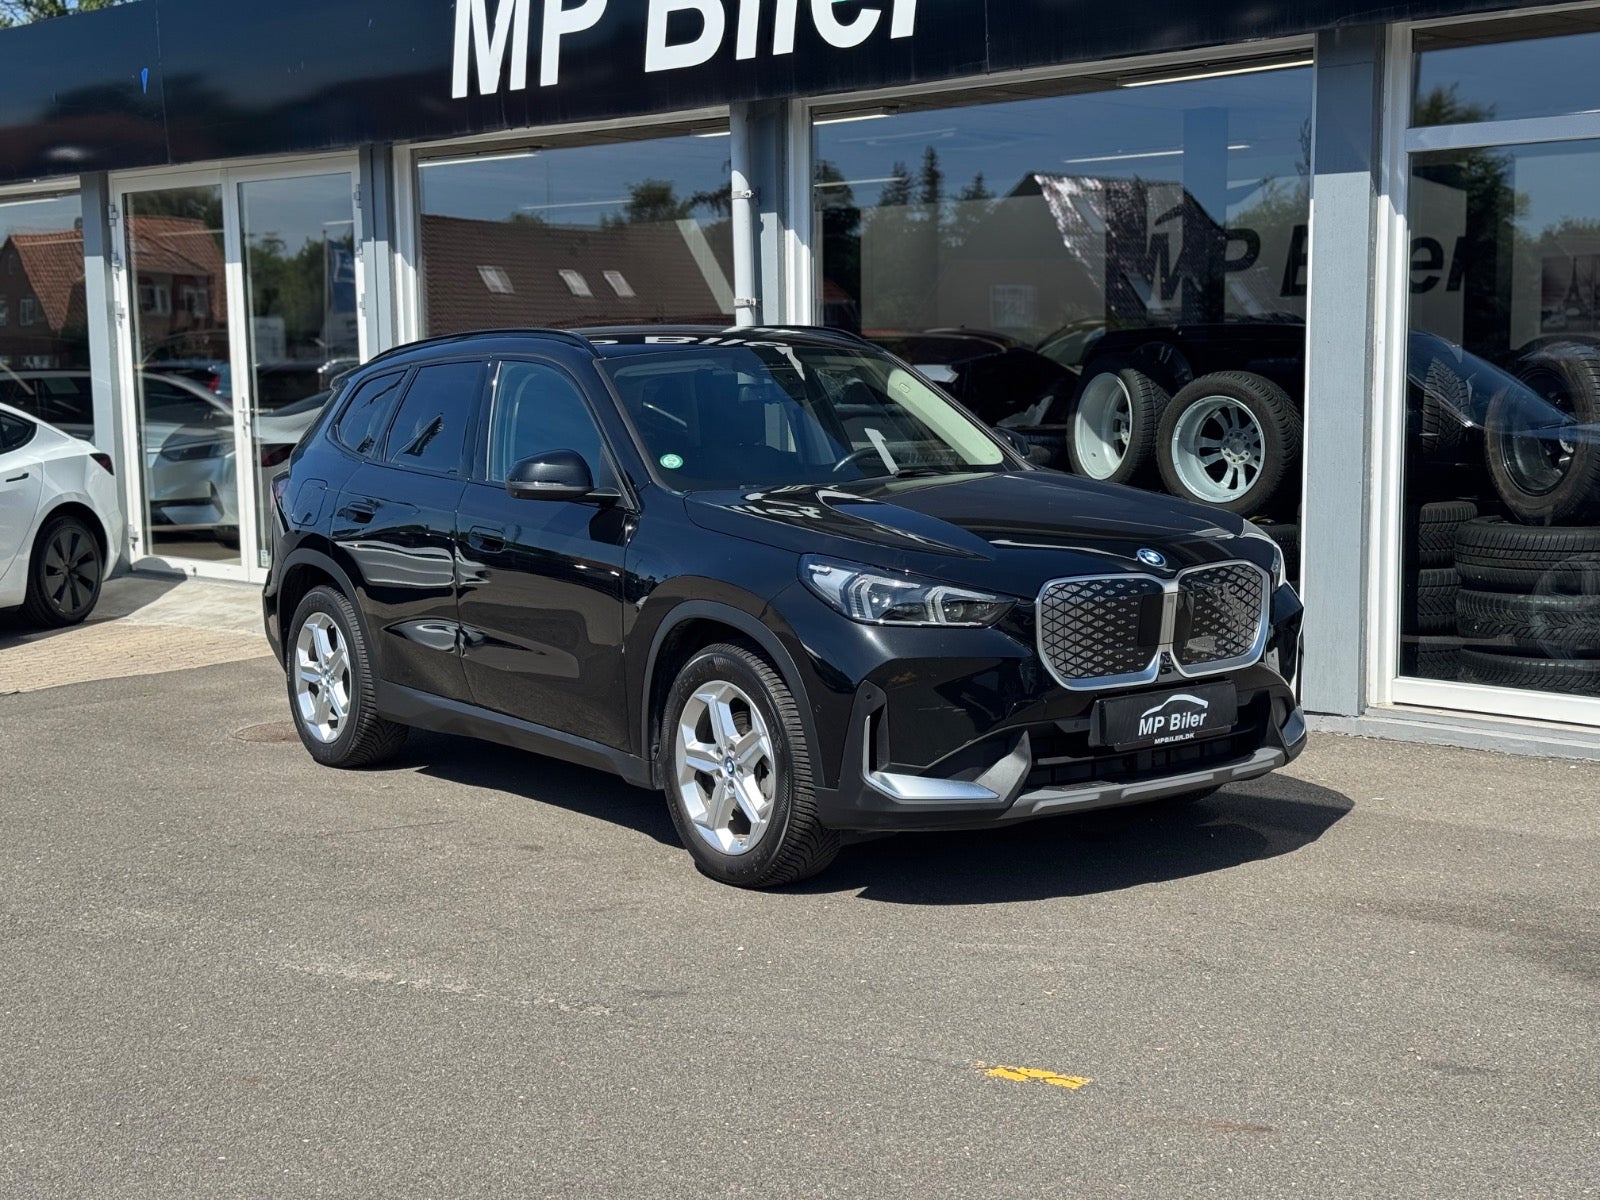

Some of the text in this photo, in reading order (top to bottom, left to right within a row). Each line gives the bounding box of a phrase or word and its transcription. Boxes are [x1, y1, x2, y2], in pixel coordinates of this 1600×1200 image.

[452, 0, 606, 98] MP
[1138, 711, 1207, 736] MP Biler
[1154, 732, 1195, 745] MPBILER.DK
